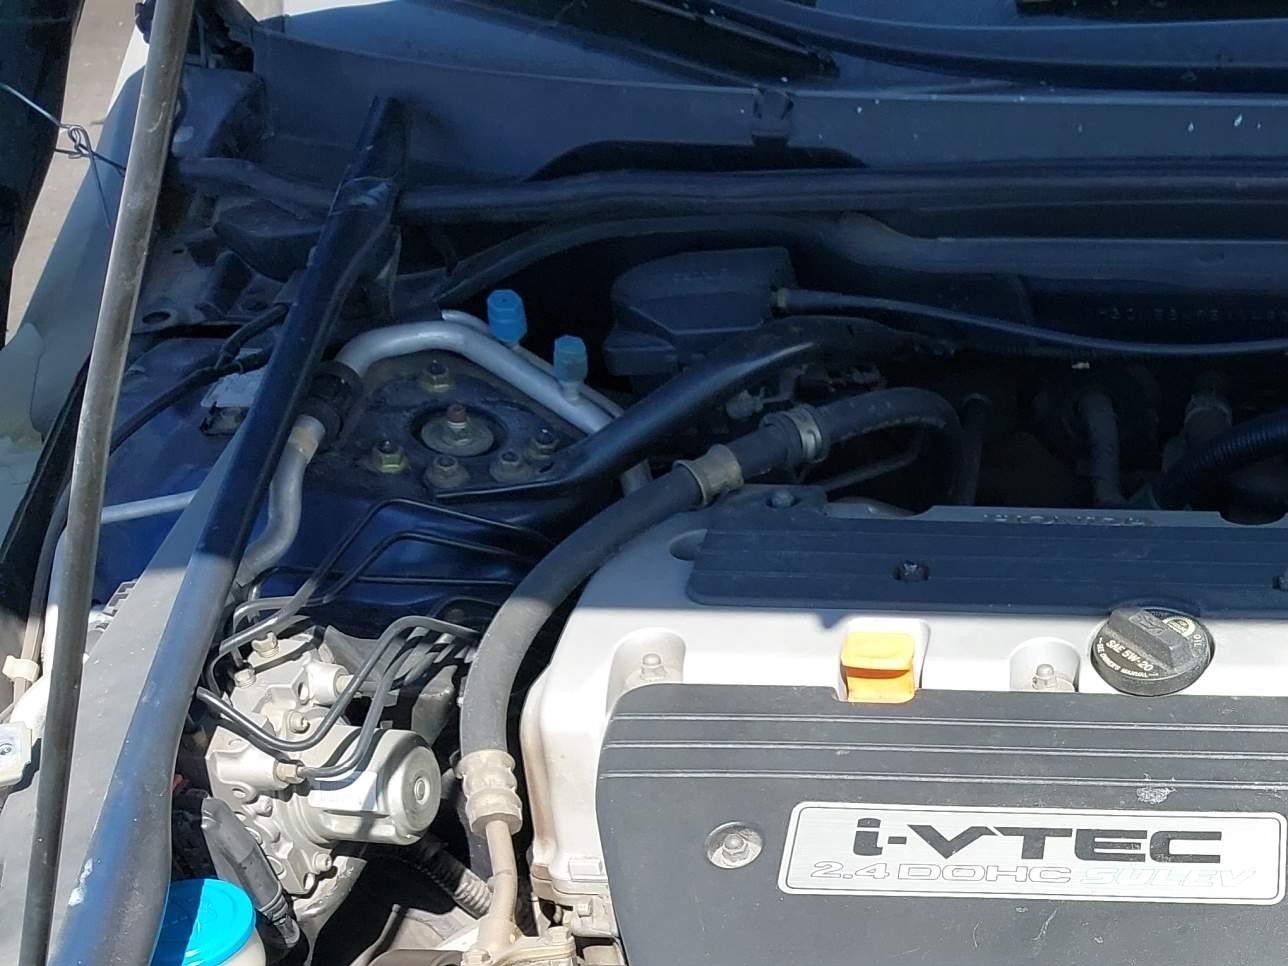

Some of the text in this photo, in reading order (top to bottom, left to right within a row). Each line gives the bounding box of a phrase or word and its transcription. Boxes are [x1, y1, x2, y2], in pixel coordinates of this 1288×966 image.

[1105, 639, 1126, 654] SAE
[852, 817, 1223, 864] i-VTEC
[809, 861, 890, 881] 2.4
[896, 863, 1072, 884] DOHC
